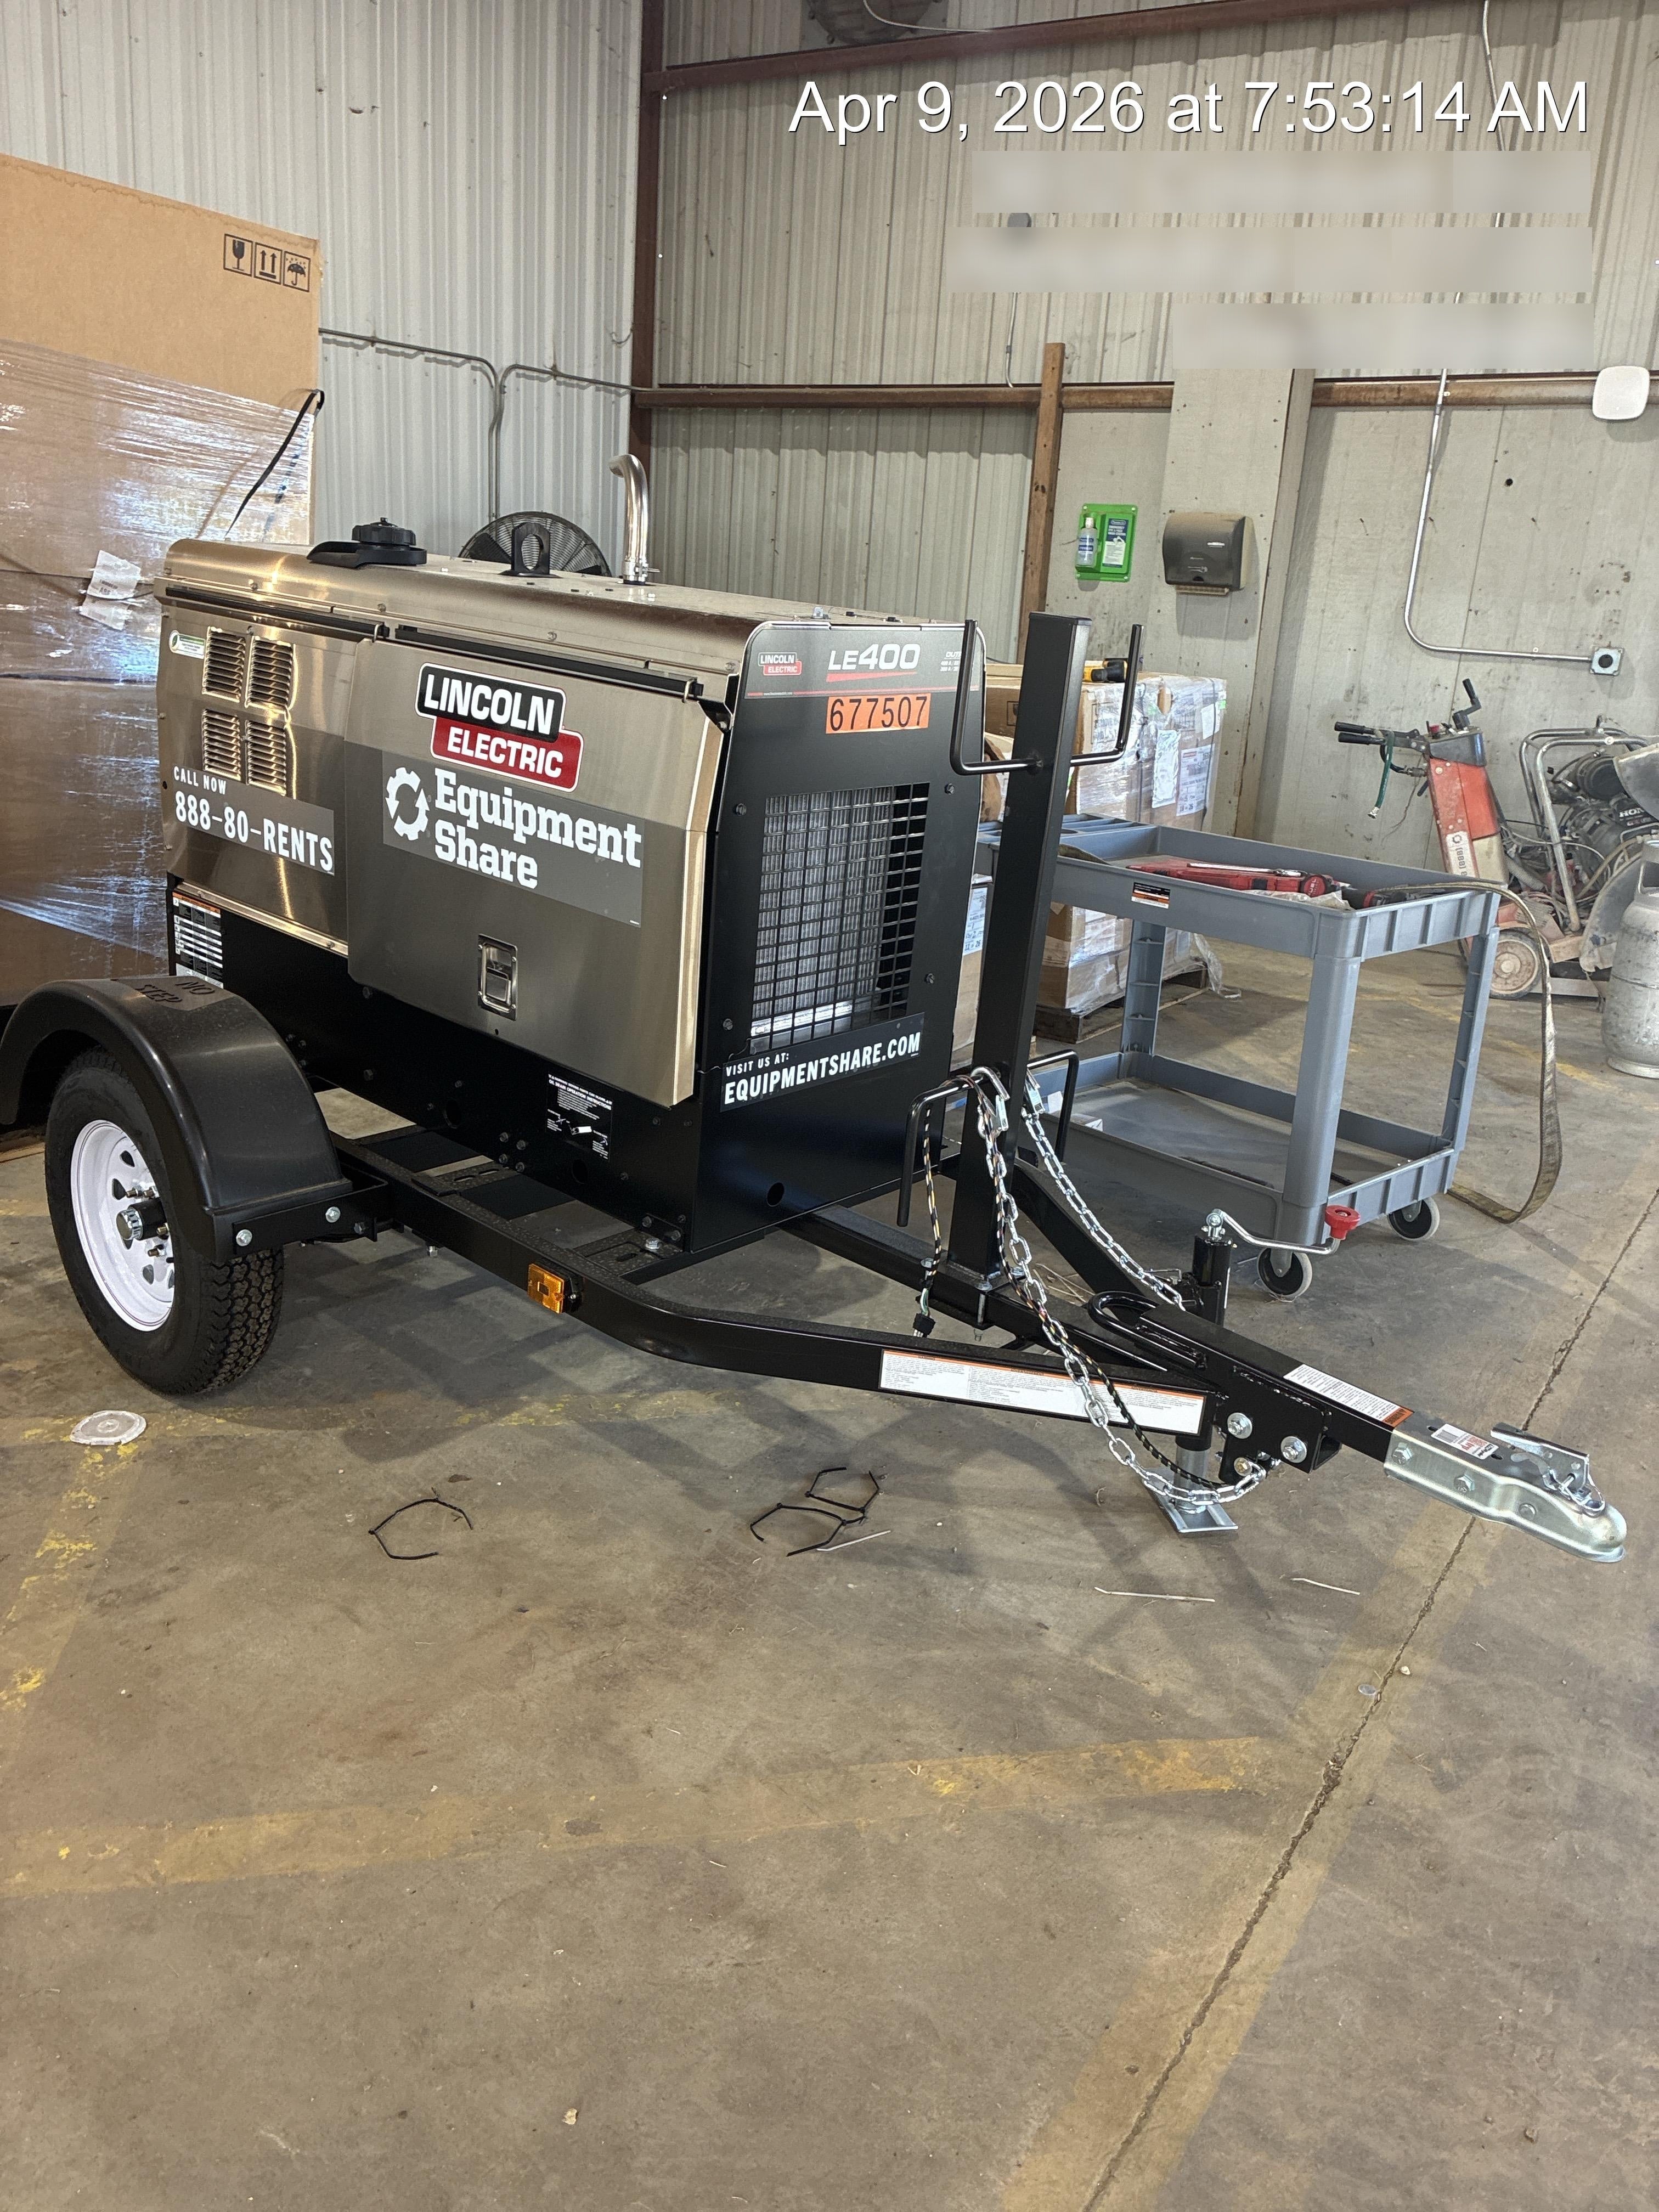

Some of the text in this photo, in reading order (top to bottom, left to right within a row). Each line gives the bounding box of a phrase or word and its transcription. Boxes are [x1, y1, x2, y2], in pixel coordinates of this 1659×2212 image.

[760, 654, 794, 664] LINCOLN
[768, 665, 797, 674] ELECTRIC
[827, 644, 921, 671] LE400
[424, 673, 555, 735] LINCOLN
[830, 696, 928, 731] 677507
[447, 726, 564, 778] ELECTRIC
[173, 766, 227, 795] CALL NOW
[175, 791, 334, 872] 888-80-RENTS
[435, 767, 642, 868] Equipment
[434, 819, 539, 890] Share
[176, 981, 215, 995] NO
[724, 1032, 921, 1104] EQUIPMENTSHARE.COM
[726, 1052, 790, 1077] VISIT US AT:
